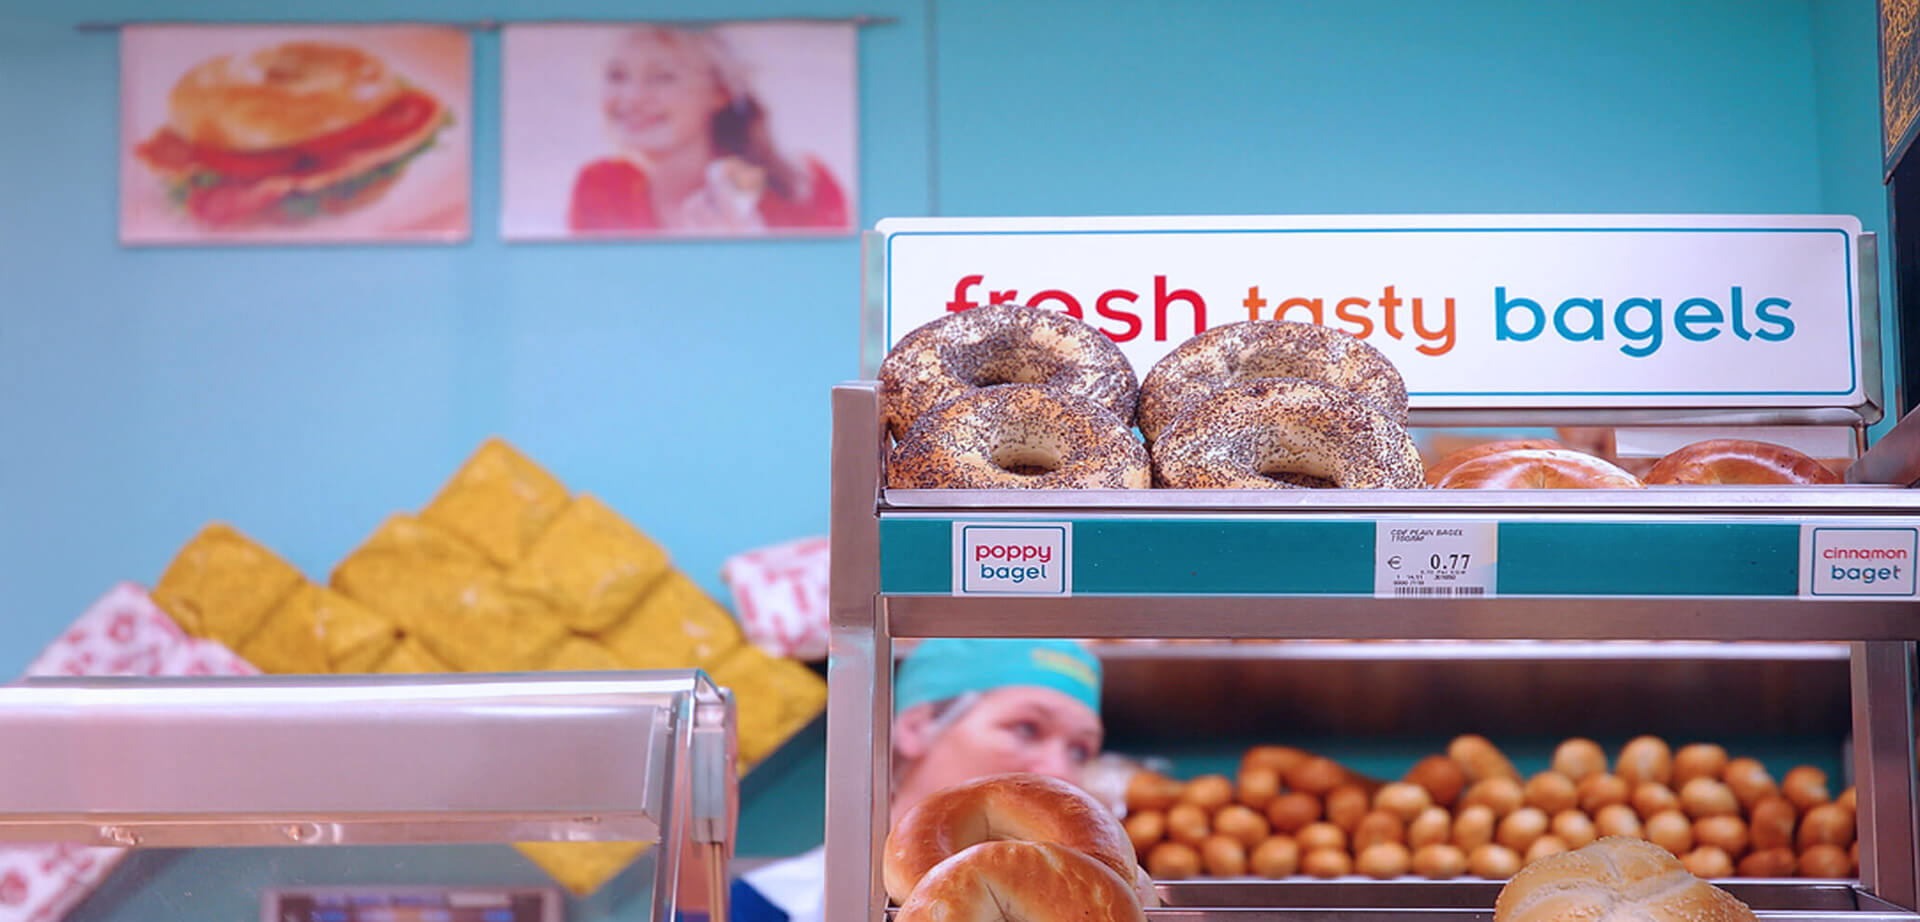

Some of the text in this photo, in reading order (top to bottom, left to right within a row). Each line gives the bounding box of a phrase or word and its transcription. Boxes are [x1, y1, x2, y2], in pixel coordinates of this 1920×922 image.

[1243, 285, 1455, 356] tasty
[1494, 286, 1795, 357] bagels
[975, 545, 1051, 563] poppy
[1387, 554, 1470, 570] € 0.77
[1822, 547, 1907, 559] cinnamon
[981, 564, 1047, 583] bagel
